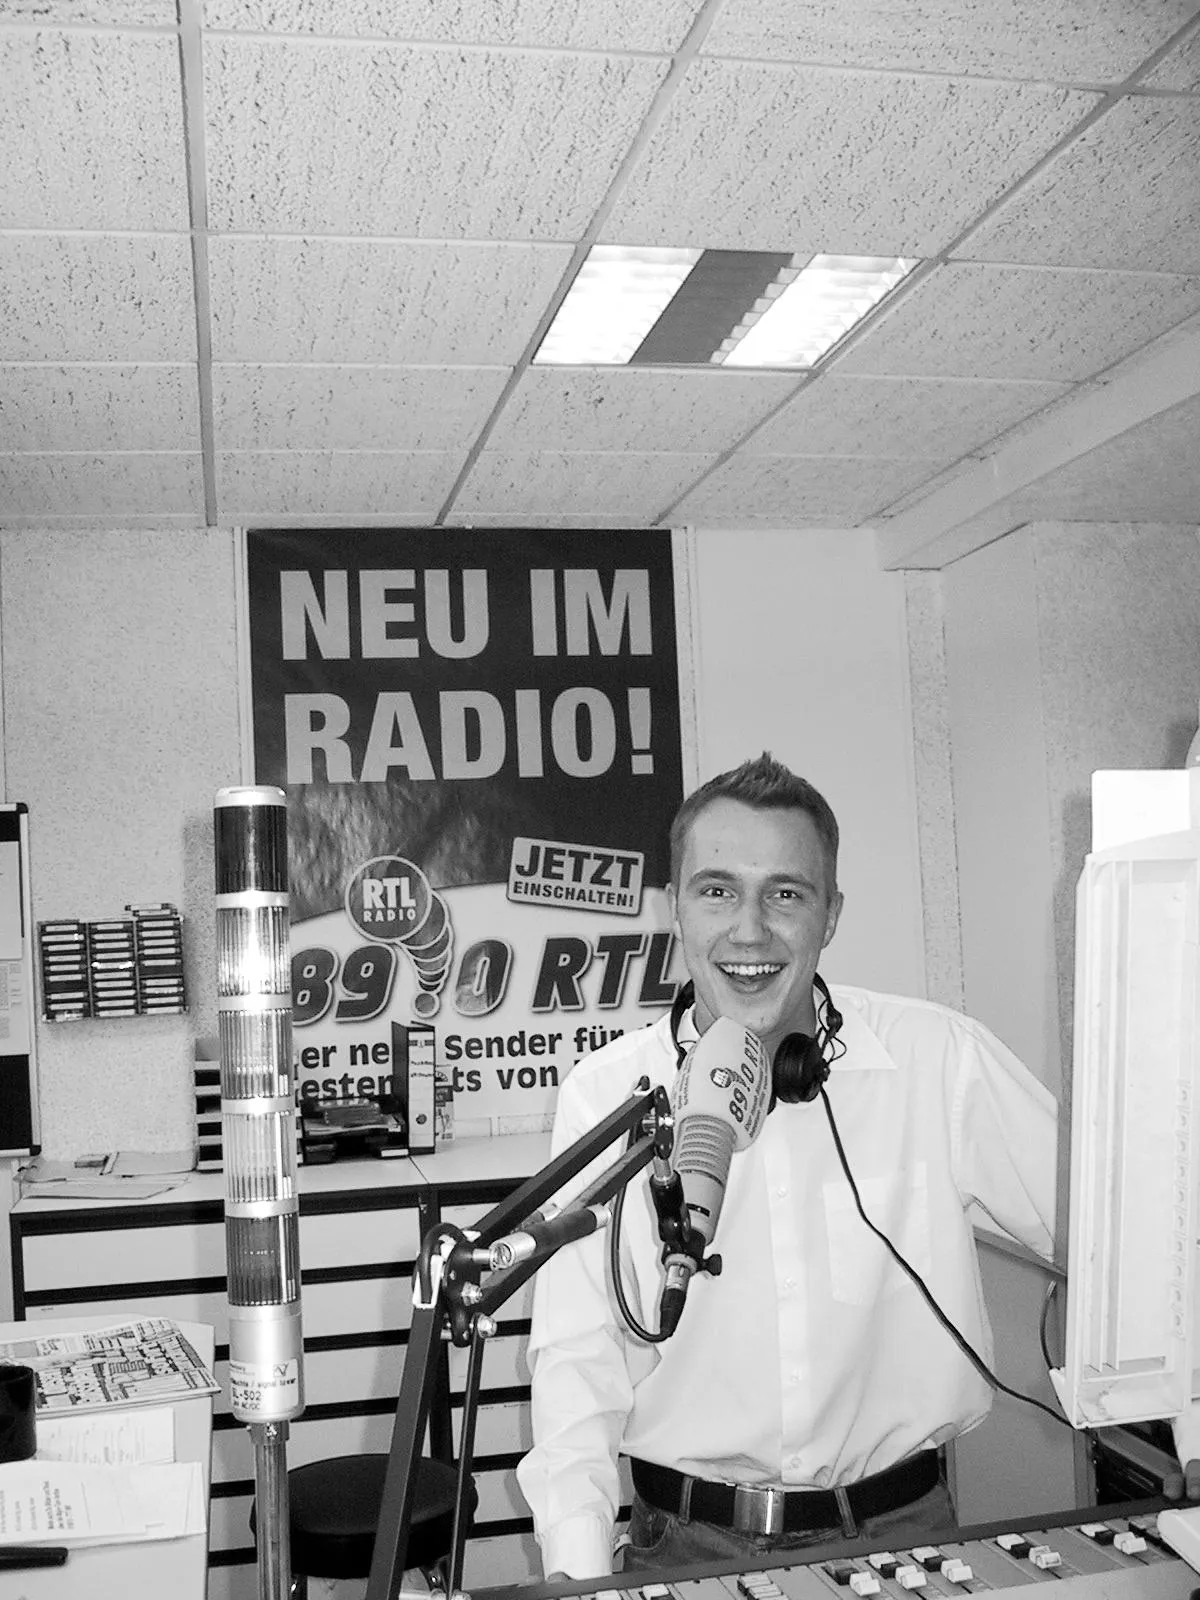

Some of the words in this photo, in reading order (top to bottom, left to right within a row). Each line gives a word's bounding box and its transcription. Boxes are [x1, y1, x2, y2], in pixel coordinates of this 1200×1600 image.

[280, 569, 490, 660] NEU
[530, 569, 653, 656] IM
[284, 687, 654, 784] RADIO!
[515, 845, 640, 888] JETZT
[363, 877, 417, 909] RTL
[513, 880, 635, 908] EINSCHALTEN!
[363, 908, 417, 922] RADIO
[531, 932, 679, 1011] RTL
[300, 1044, 337, 1070] er
[444, 1031, 563, 1061] Sender
[300, 1072, 394, 1100] esten
[496, 1064, 559, 1090] von
